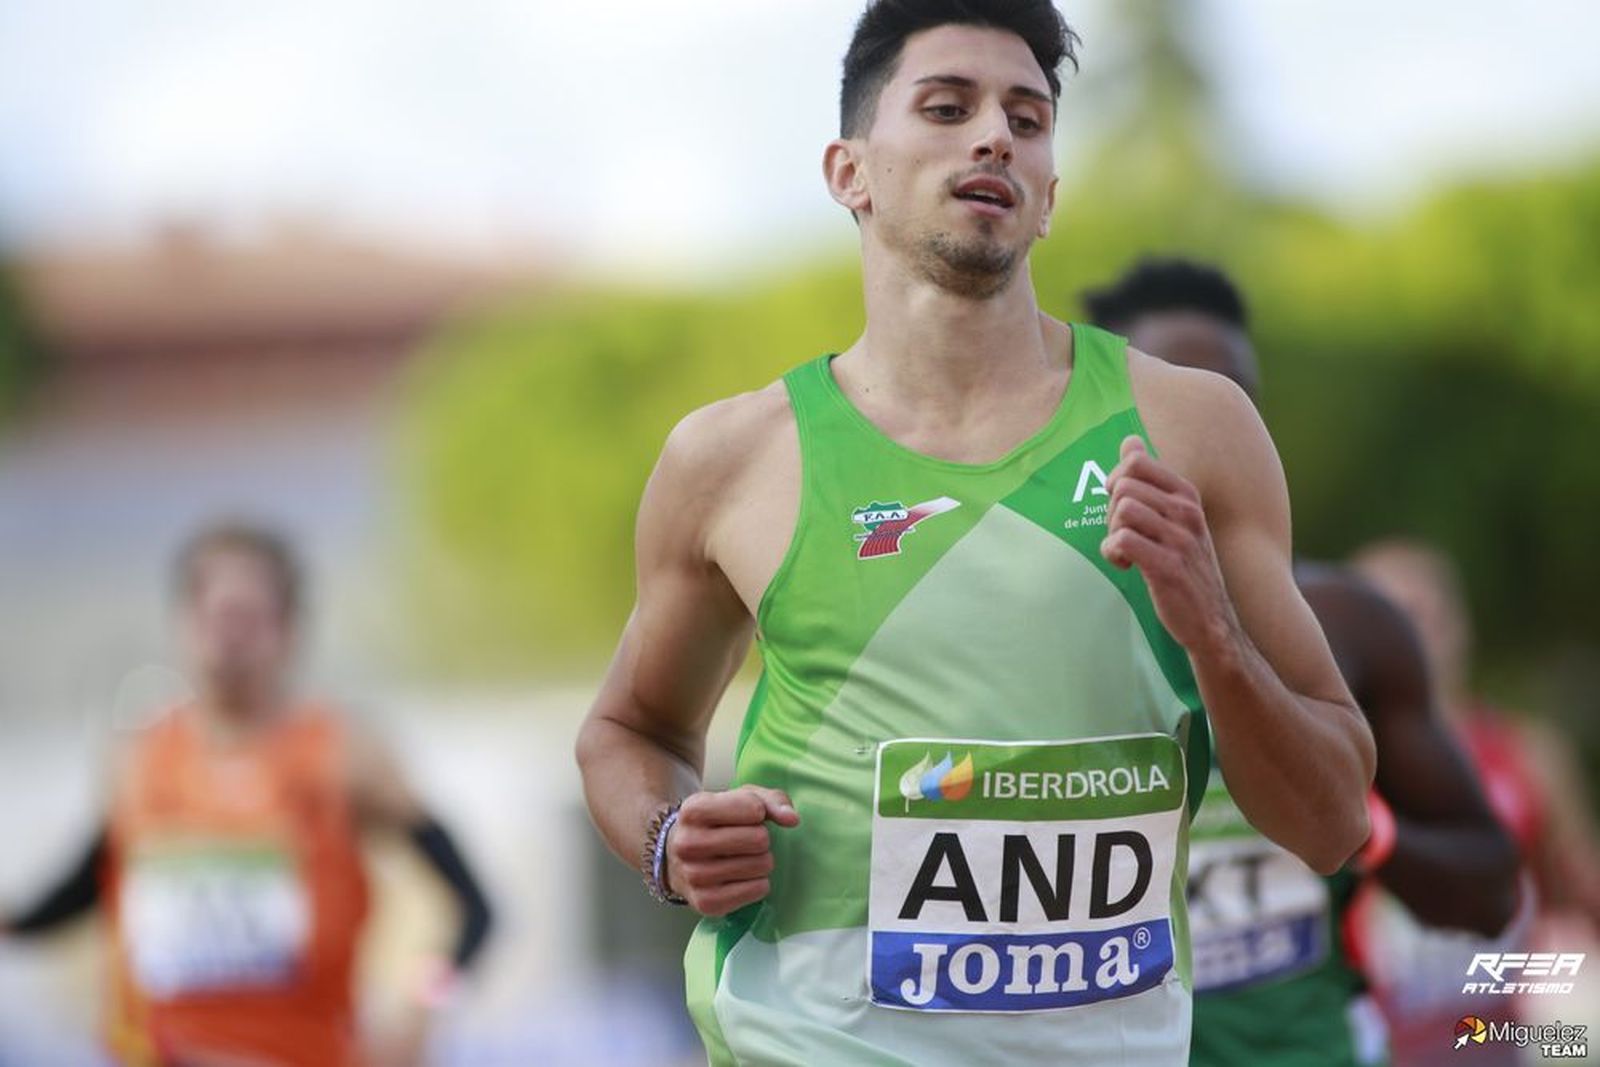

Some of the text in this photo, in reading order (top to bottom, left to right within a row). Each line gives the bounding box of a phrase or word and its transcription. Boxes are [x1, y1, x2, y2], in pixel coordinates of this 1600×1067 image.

[1064, 514, 1108, 529] de And
[1083, 504, 1108, 515] Junt
[982, 764, 1171, 800] IBERDROLA
[897, 830, 1154, 923] AND
